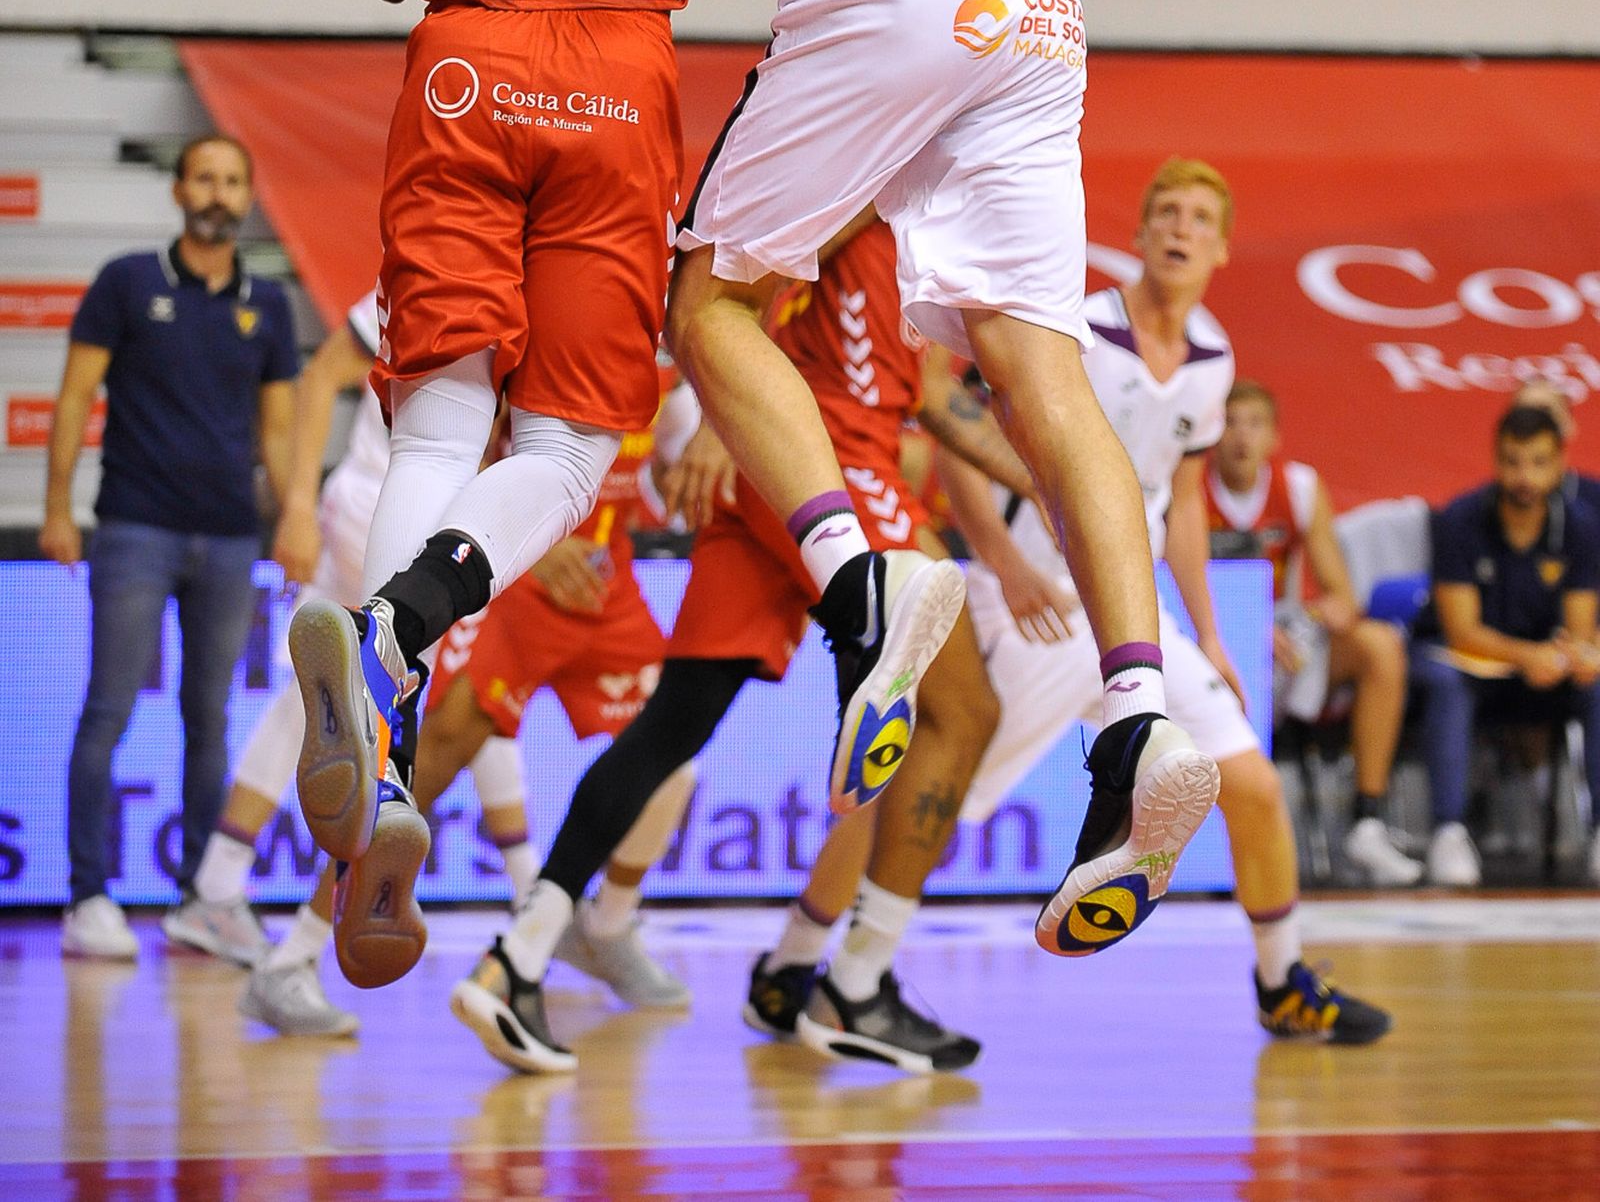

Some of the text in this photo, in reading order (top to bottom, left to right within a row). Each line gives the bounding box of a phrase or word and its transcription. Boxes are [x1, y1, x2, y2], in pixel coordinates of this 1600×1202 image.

[1019, 16, 1056, 38] DEL
[1013, 37, 1083, 68] MÁLAGA
[492, 83, 640, 124] Costa Cálida
[492, 109, 593, 133] Región de Murcia
